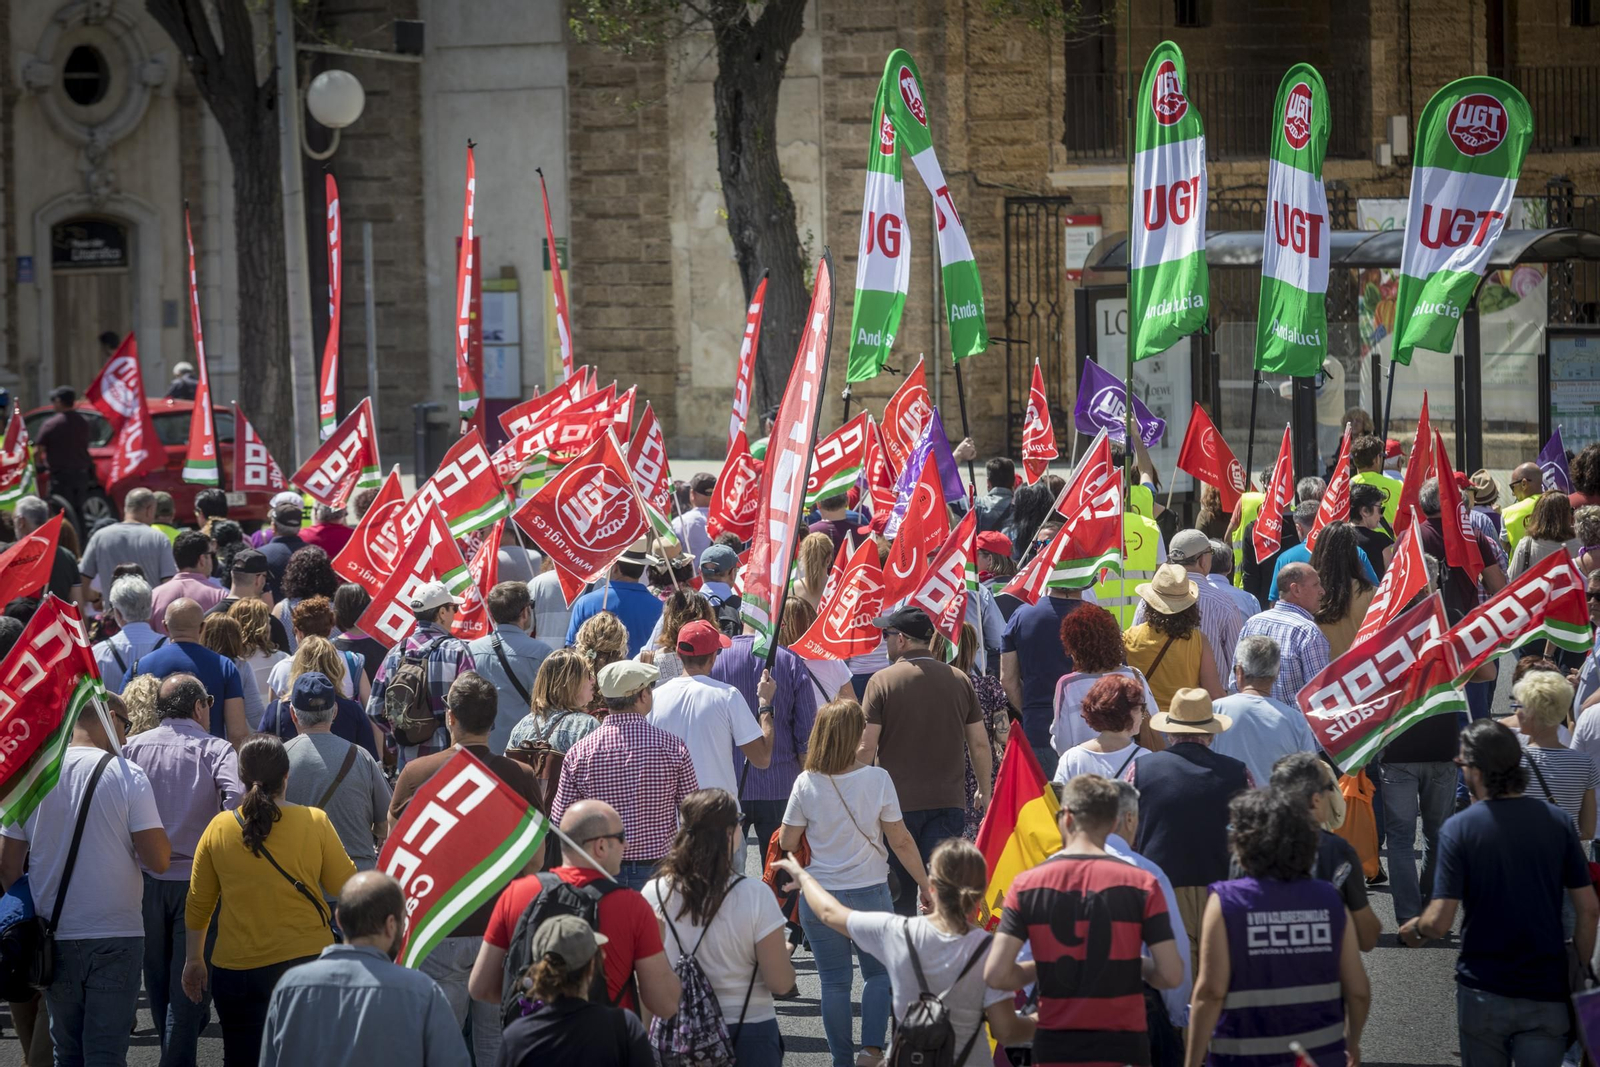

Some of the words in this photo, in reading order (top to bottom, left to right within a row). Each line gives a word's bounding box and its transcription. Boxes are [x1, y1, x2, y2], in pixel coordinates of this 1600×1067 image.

[1157, 71, 1181, 95] UGT
[1290, 92, 1312, 120] UGT
[1456, 103, 1501, 126] UGT
[1144, 174, 1200, 231] UGT
[867, 211, 902, 259] UG
[1274, 200, 1323, 258] UGT
[1420, 204, 1504, 250] UGT
[1271, 319, 1322, 346] Andalucí
[1096, 390, 1127, 417] UG
[1230, 463, 1245, 492] UGT
[561, 470, 620, 533] UGT
[531, 515, 594, 572] www.ugt.es
[828, 569, 884, 638] UGT
[1247, 923, 1332, 948] CCOO
